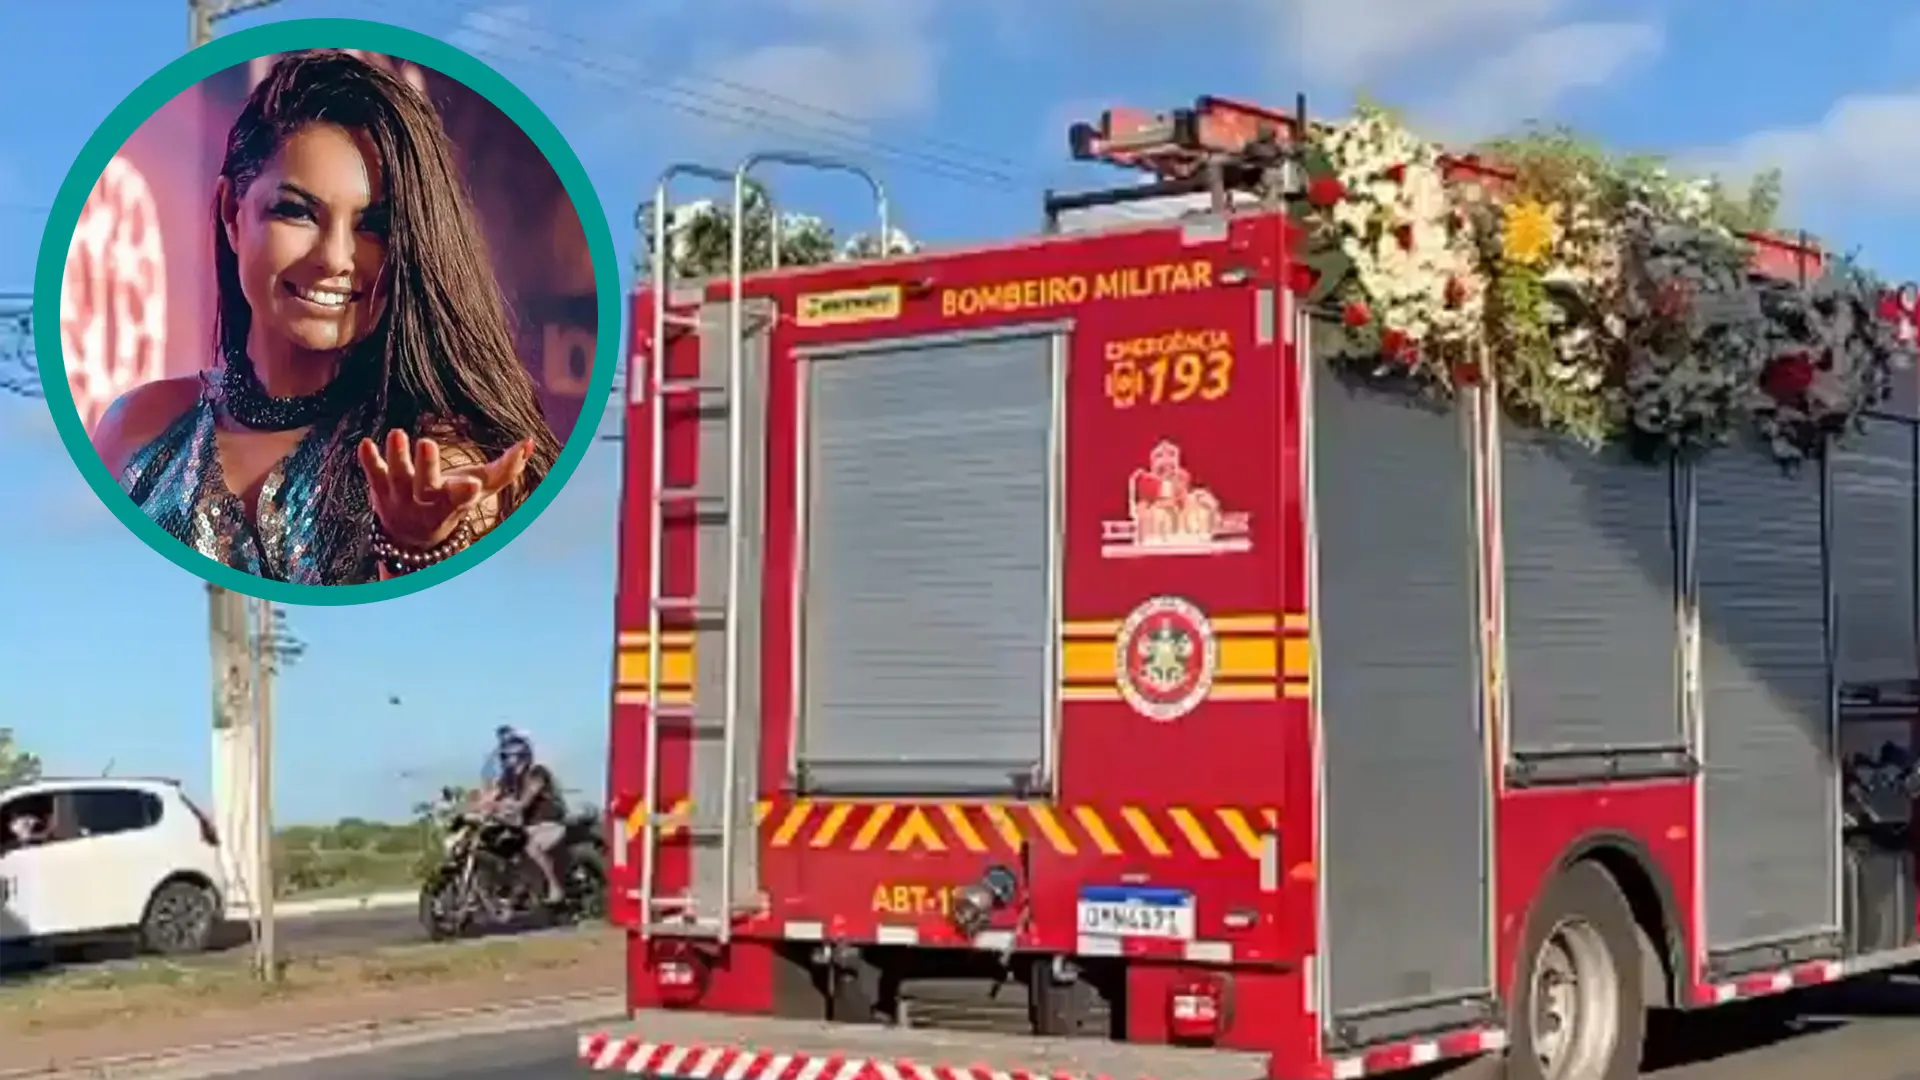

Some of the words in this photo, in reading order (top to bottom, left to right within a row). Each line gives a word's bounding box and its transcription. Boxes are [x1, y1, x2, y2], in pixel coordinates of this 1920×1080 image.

[942, 275, 1088, 317] BOMBEIRO
[1094, 260, 1213, 300] MILITAR
[1148, 350, 1233, 405] 193
